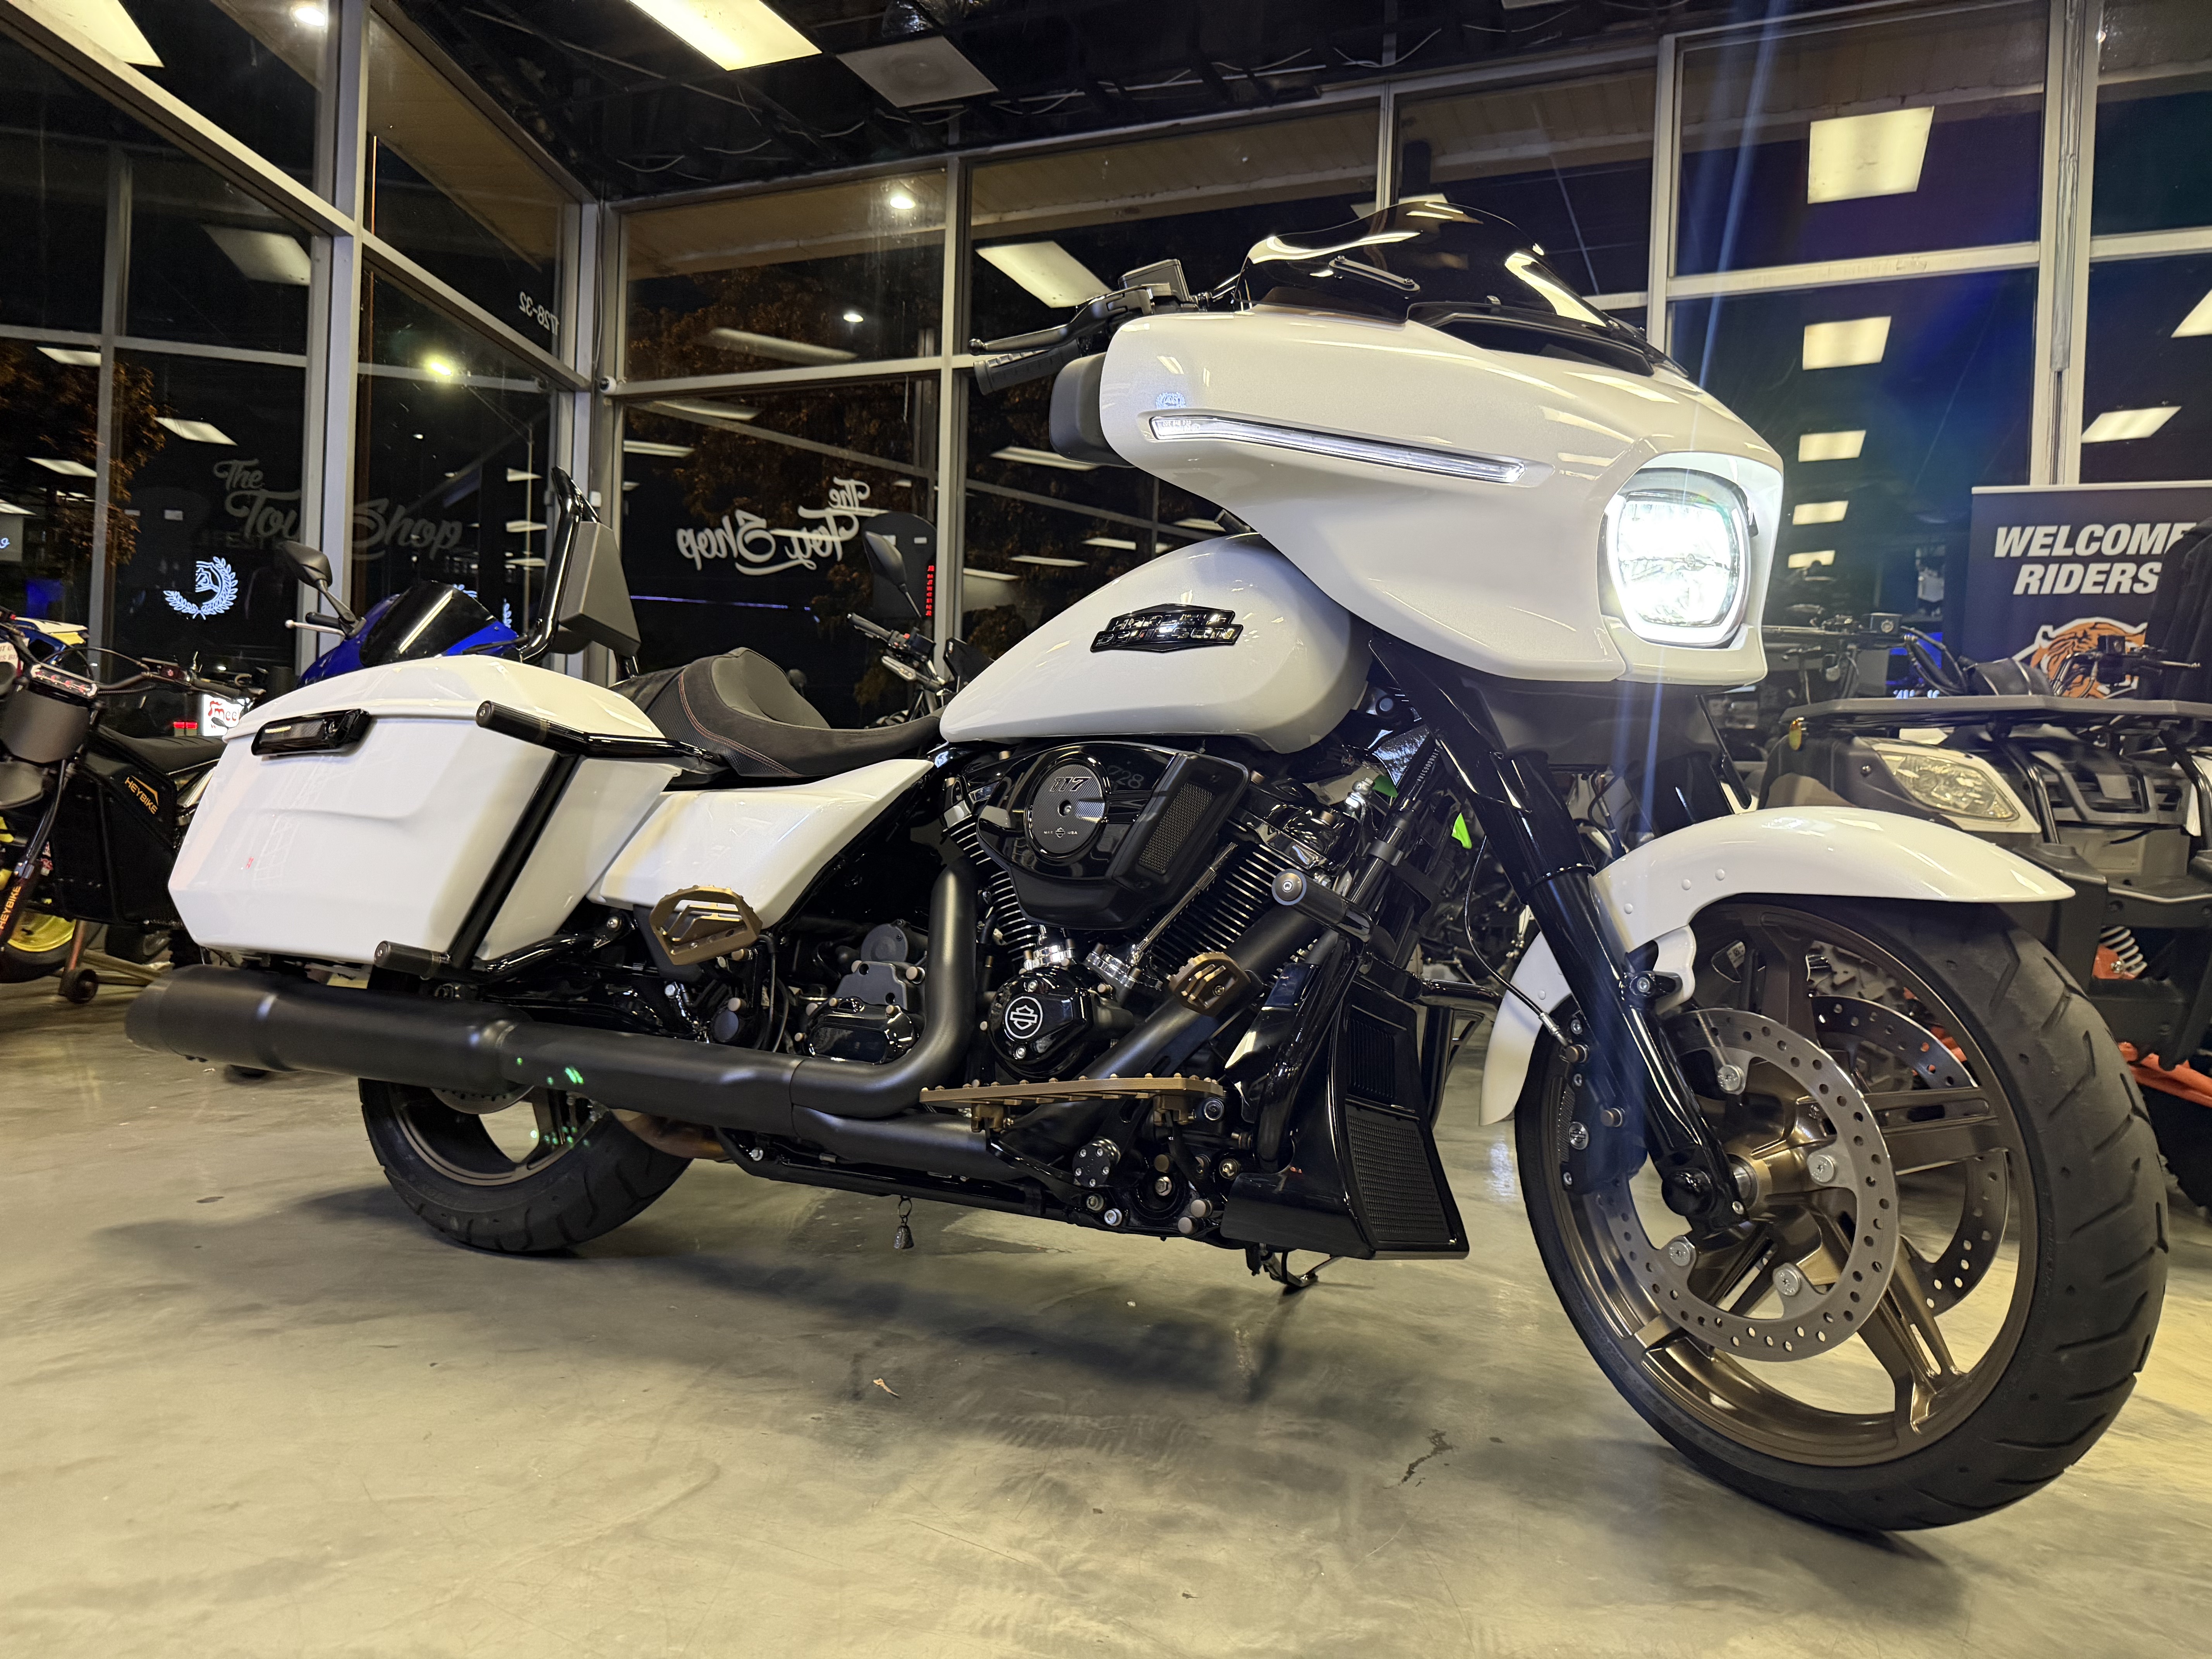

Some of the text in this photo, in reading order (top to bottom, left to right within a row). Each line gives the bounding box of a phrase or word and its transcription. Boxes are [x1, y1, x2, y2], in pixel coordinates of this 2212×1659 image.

[213, 459, 265, 491] The
[352, 498, 463, 561] Shop
[2013, 562, 2162, 594] RIDERS
[1095, 627, 1236, 647] DAVIDSON
[125, 777, 158, 814] HEYBIKE
[1049, 776, 1092, 792] 117
[0, 886, 21, 929] HEYBIKE
